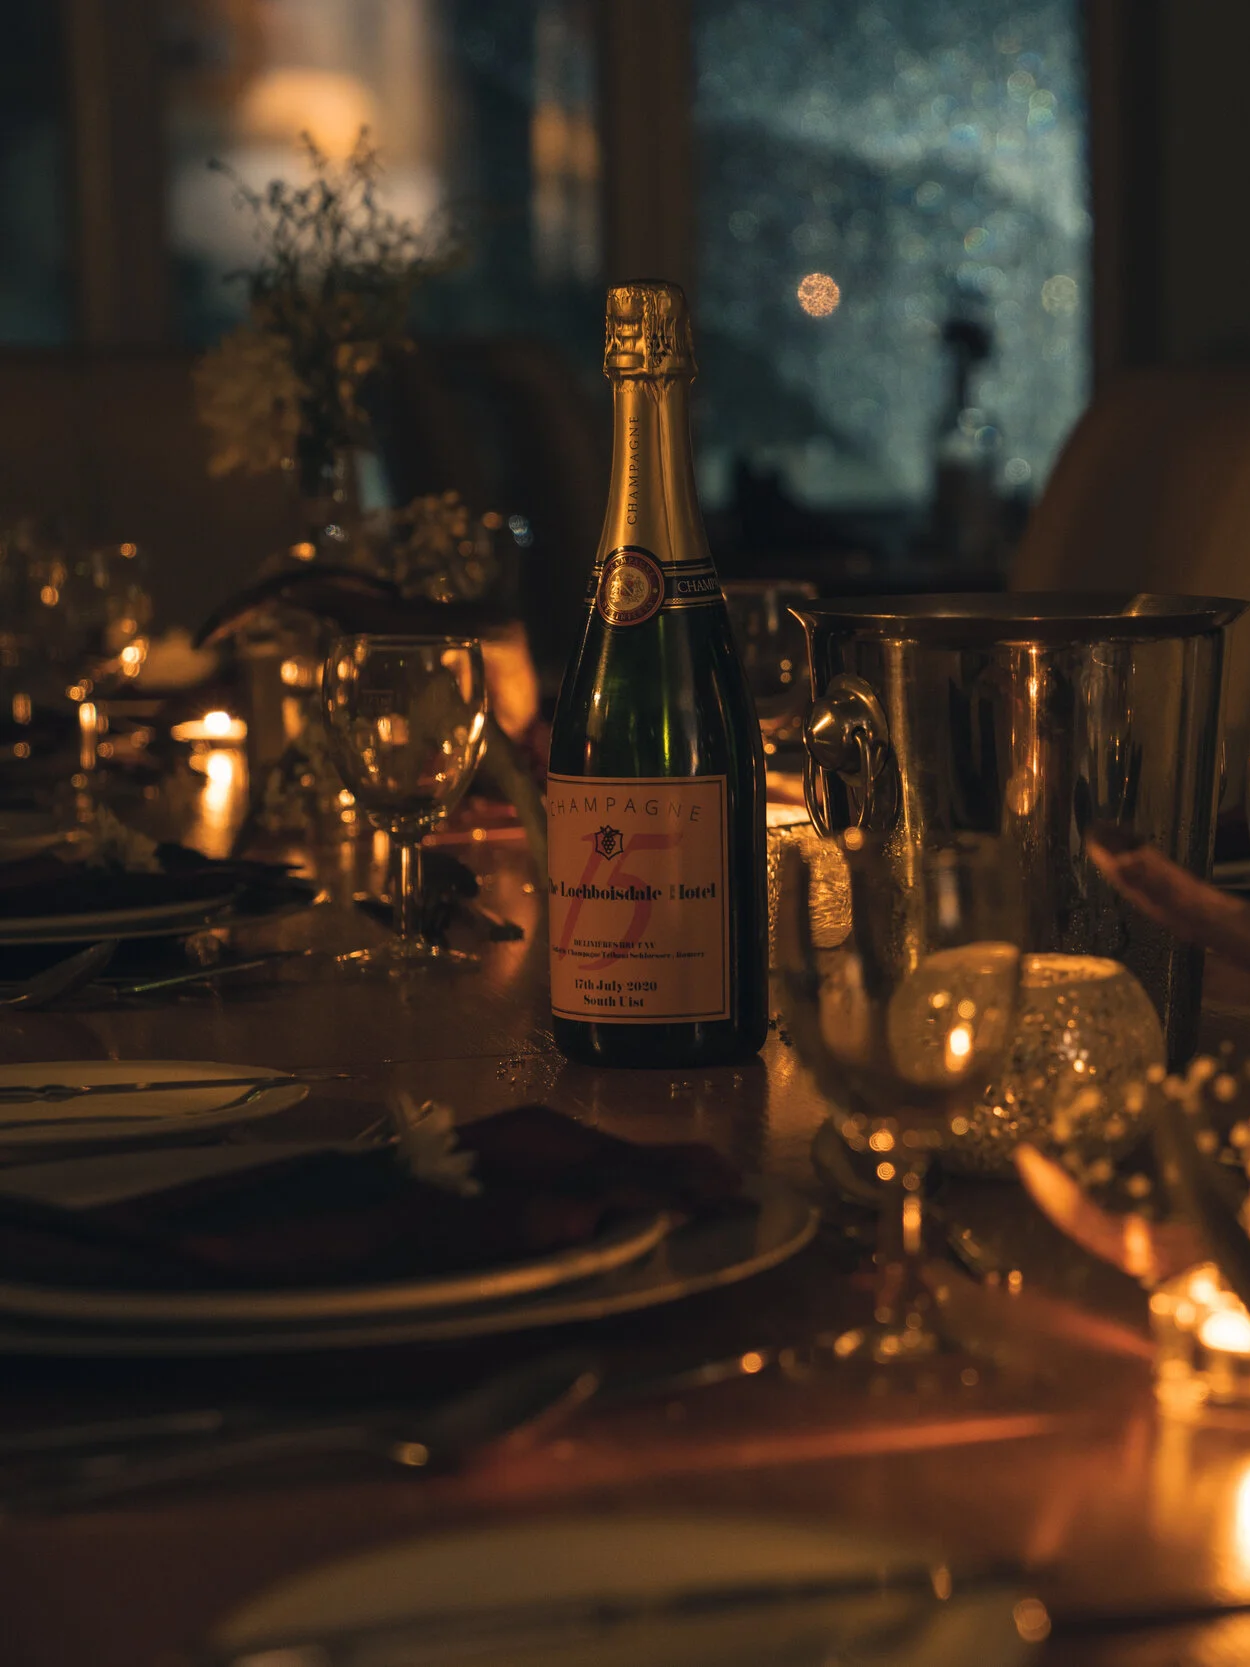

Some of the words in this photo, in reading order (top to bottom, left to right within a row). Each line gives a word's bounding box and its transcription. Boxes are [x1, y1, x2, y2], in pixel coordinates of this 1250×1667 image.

[627, 416, 640, 525] CHAMPAGNE
[550, 797, 702, 822] CHAMPAGNE
[561, 881, 662, 901] Lochboisdale
[669, 882, 716, 900] Hotel
[575, 979, 595, 990] 17th
[596, 980, 622, 993] July
[627, 981, 657, 991] 2020
[583, 995, 616, 1007] South
[619, 996, 644, 1007] Uist
